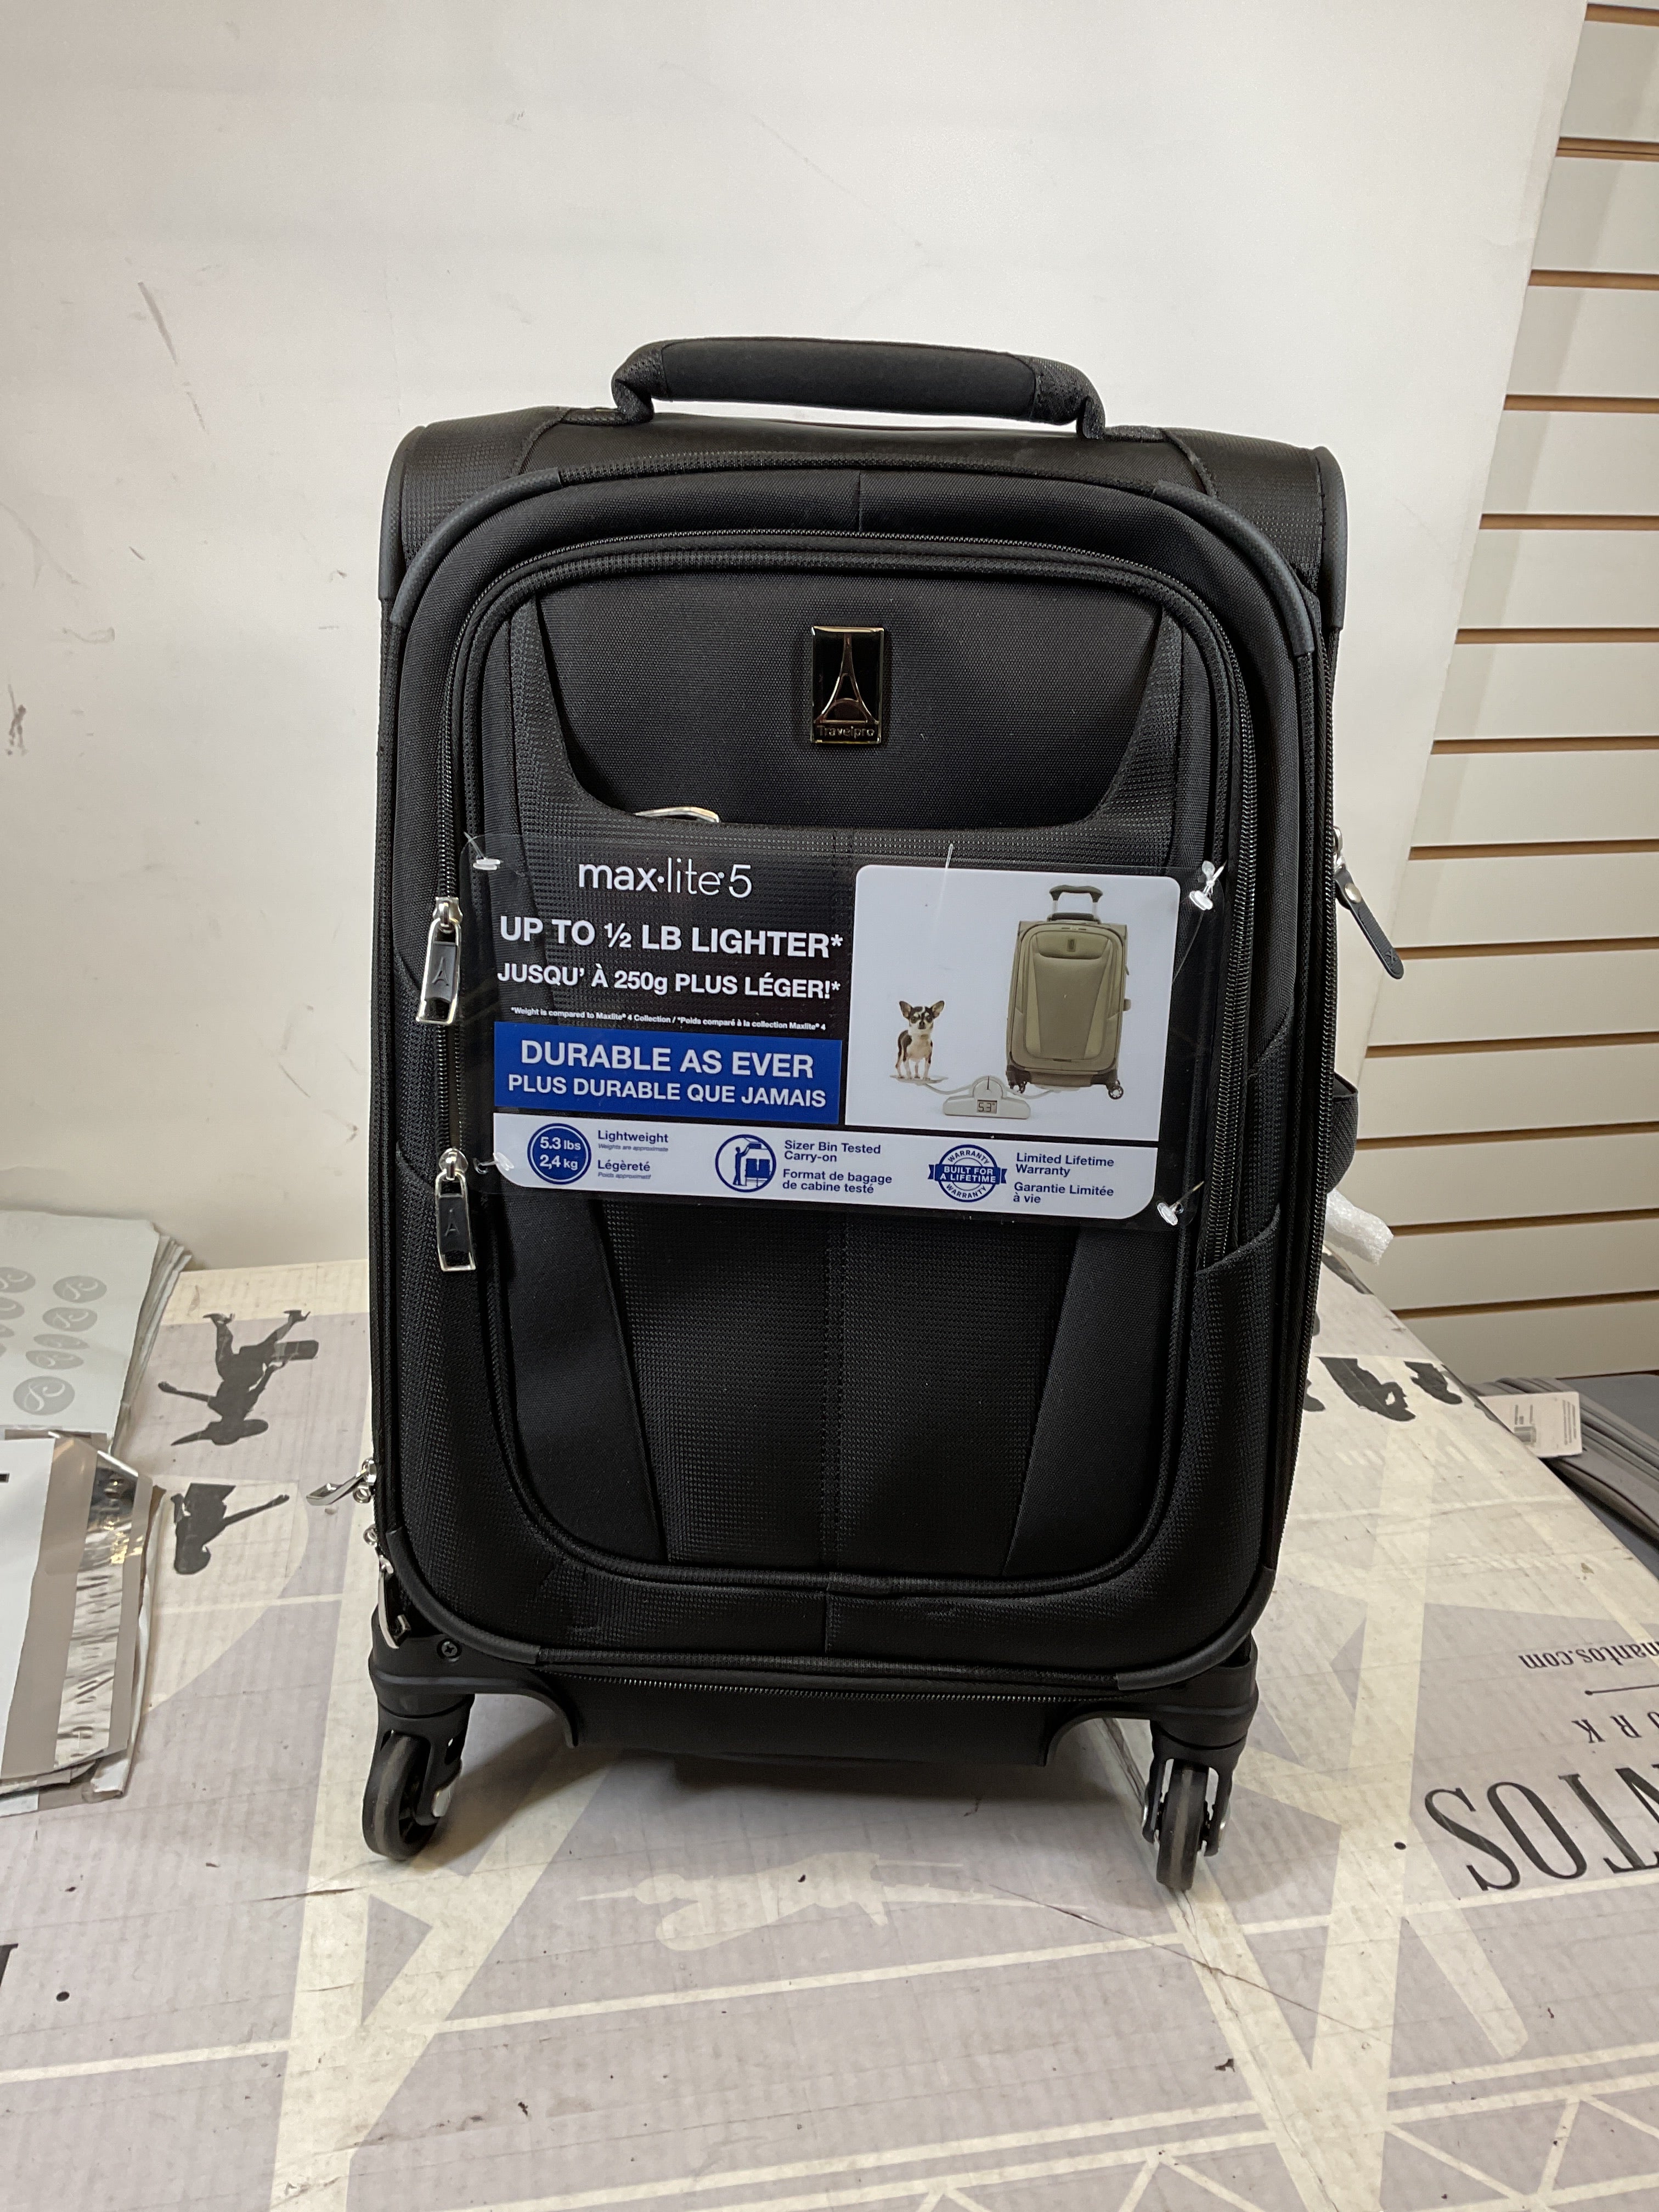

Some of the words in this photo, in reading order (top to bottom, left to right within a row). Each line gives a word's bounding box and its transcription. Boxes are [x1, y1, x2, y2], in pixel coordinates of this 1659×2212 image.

[500, 916, 543, 941] UP
[551, 919, 595, 946] TO
[642, 924, 682, 950] LB
[591, 963, 608, 988] À
[614, 970, 668, 995] 250g
[675, 973, 738, 995] PLUS
[549, 1010, 585, 1019] compared
[634, 1014, 670, 1023] Collection
[703, 1019, 735, 1028] comparé
[752, 1021, 787, 1029] collection
[521, 1040, 671, 1071] DURABLE
[680, 1049, 722, 1074] AS
[732, 1051, 814, 1078] EVER
[509, 1074, 567, 1094] PLUS
[574, 1078, 681, 1101] DURABLE
[687, 1084, 735, 1103] QUE
[741, 1086, 826, 1108] JAMAIS
[540, 1136, 561, 1150] 5.3
[563, 1140, 581, 1150] lbs
[597, 1130, 668, 1144] Lightweight
[785, 1140, 815, 1150] Sizer
[819, 1142, 837, 1152] Bin
[842, 1143, 881, 1154] Tested
[540, 1154, 561, 1169] 2,4
[563, 1159, 578, 1170] kg
[784, 1151, 837, 1163] Carry-on
[948, 1150, 990, 1164] WARRANTY
[1017, 1152, 1062, 1164] Limited
[1065, 1155, 1114, 1166] Lifetime
[598, 1160, 651, 1172] Légèreté
[944, 1166, 971, 1174] BUILT
[1015, 1164, 1070, 1177] Warranty
[783, 1169, 825, 1180] Format
[829, 1171, 844, 1181] de
[848, 1172, 892, 1185] bagage
[950, 1175, 996, 1183] LIFETIME
[782, 1180, 797, 1189] de
[801, 1182, 840, 1192] cabine
[844, 1183, 874, 1193] testé
[946, 1183, 986, 1199] WARRANTY
[1014, 1182, 1065, 1193] Garantie
[1070, 1184, 1114, 1196] Limitée
[1013, 1192, 1020, 1202] à
[1024, 1194, 1041, 1203] vie
